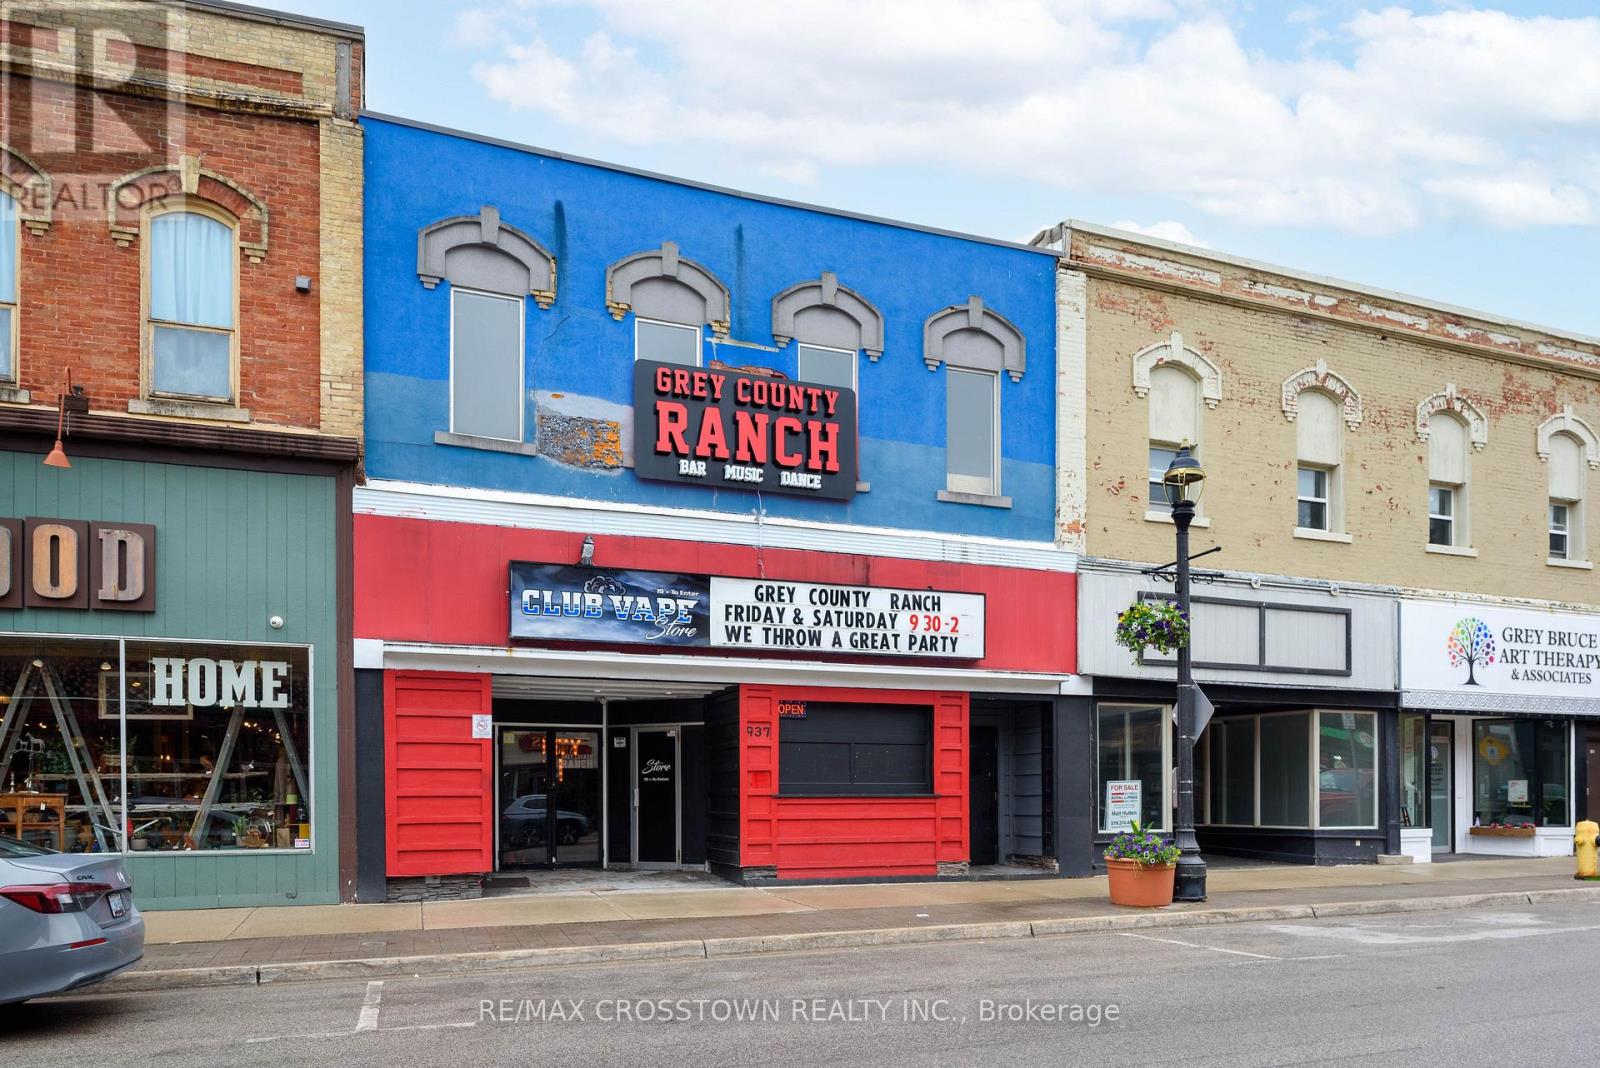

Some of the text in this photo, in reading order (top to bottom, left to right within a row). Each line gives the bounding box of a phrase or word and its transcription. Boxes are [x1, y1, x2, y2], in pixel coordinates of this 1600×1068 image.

[656, 366, 839, 415] GREY COUNTY
[656, 400, 840, 473] RANCH
[679, 459, 822, 490] BAR MUSIC DANCE
[0, 524, 145, 601] OD
[521, 588, 698, 624] CLUB VAPE
[754, 584, 941, 612] GREY COUNTY RANCH
[645, 616, 697, 640] Store
[724, 604, 786, 624] FRIDAY
[792, 607, 804, 625] &
[813, 609, 898, 631] SATURDAY
[724, 625, 959, 653] WE THROW A GREAT PARTY
[1502, 626, 1598, 649] GREY BRUCE
[1499, 648, 1600, 670] ART THERAPY
[152, 657, 288, 708] HOME
[1511, 668, 1592, 685] & ASSOCIATES
[777, 703, 804, 715] OPEN
[747, 726, 770, 738] 937
[641, 758, 671, 774] Store
